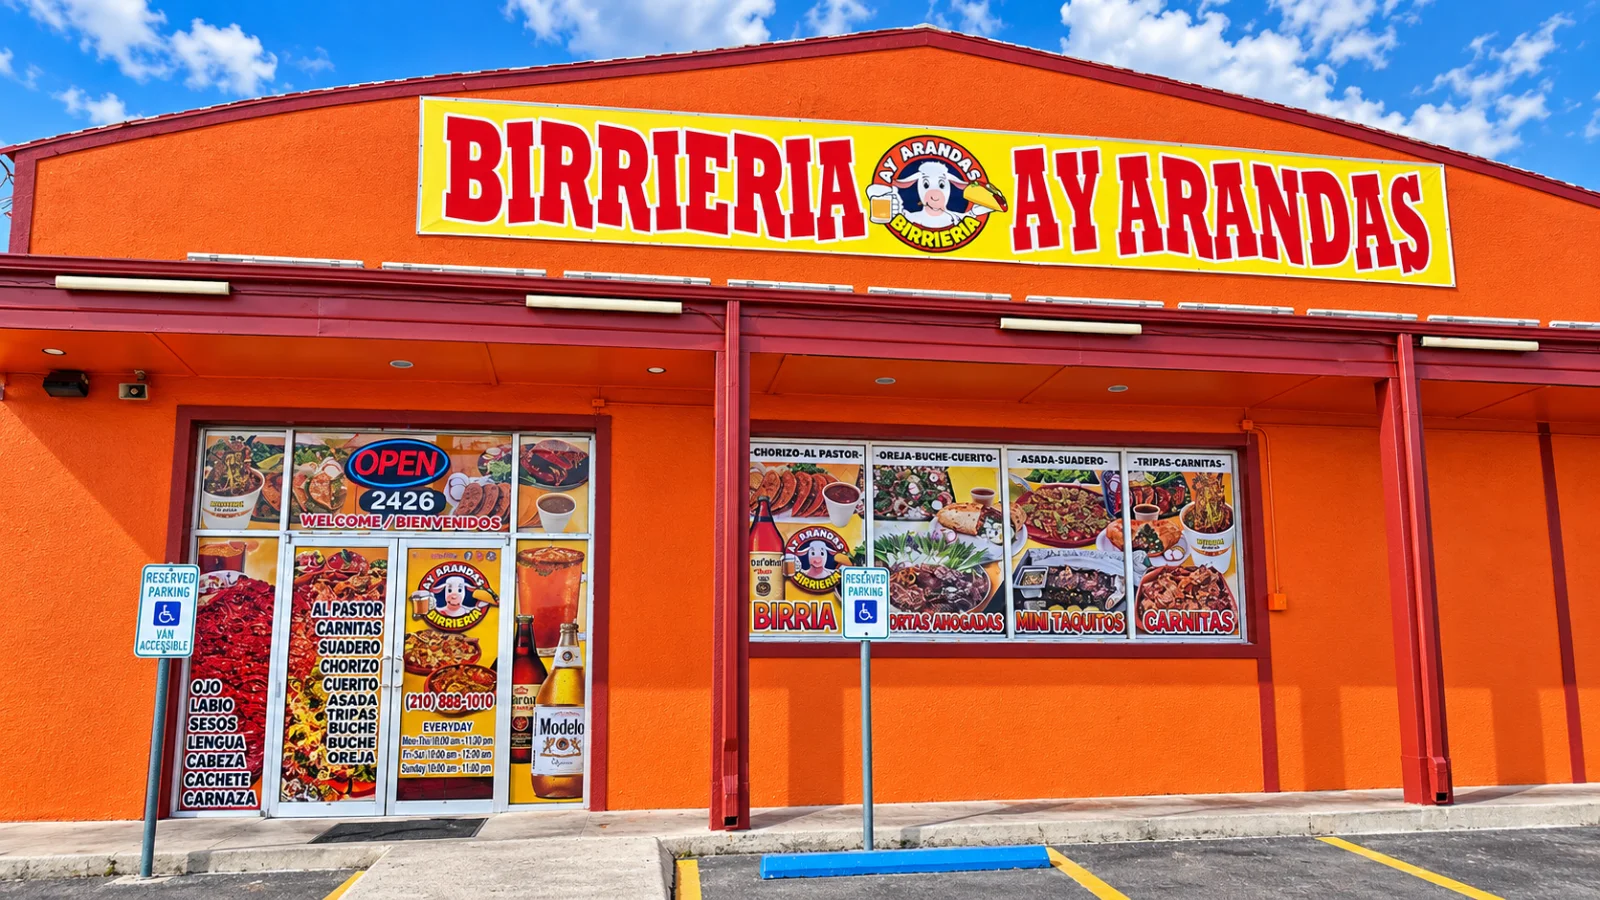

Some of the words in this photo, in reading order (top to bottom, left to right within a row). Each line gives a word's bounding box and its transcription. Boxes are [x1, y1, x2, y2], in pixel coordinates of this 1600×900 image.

[879, 157, 898, 183] AY
[900, 140, 981, 182] ARANDAS
[444, 114, 867, 242] BIRRIERIA
[1012, 147, 1099, 251] AY
[1117, 153, 1430, 274] ARANDAS
[890, 213, 981, 248] BIRRIERIA
[355, 449, 439, 476] OPEN
[370, 491, 435, 511] 2426
[301, 514, 381, 528] WELCOME
[395, 515, 501, 530] BIENVENIDOS
[146, 572, 195, 584] RESERVED
[423, 575, 434, 589] AY
[435, 564, 485, 586] ARANDAS
[845, 573, 886, 584] RESERVED
[148, 586, 190, 598] PARKING
[848, 586, 883, 597] PARKING
[312, 603, 331, 617] AL
[332, 603, 383, 617] PASTOR
[753, 601, 837, 630] BIRRIA
[316, 621, 382, 636] CARNITAS
[889, 613, 930, 631] ORTAS
[933, 613, 1003, 631] AHOGADAS
[1015, 611, 1049, 631] MINI
[1053, 611, 1125, 632] TAQUITOS
[1144, 611, 1234, 632] CARNITAS
[156, 629, 175, 640] VAN
[139, 640, 188, 651] ACCESSIBLE
[319, 640, 381, 655] SUADERO
[321, 659, 379, 673] CHORIZO
[191, 680, 222, 695] OJO
[323, 678, 378, 692] CUERITO
[190, 698, 234, 713] LABIO
[328, 694, 377, 706] ASADA
[405, 693, 436, 711] (210)
[438, 693, 493, 710] 888-1010
[327, 708, 376, 721] TRIPAS
[189, 717, 237, 731] SESOS
[328, 723, 376, 735] BUCHE
[423, 722, 473, 732] EVERYDAY
[540, 718, 585, 735] Modelo
[188, 735, 245, 750] LENGUA
[328, 737, 375, 749] BUCHE
[186, 754, 246, 769] CABEZA
[328, 751, 375, 764] OREJA
[184, 772, 250, 787] CACHETE
[183, 790, 257, 806] CARNAZA
